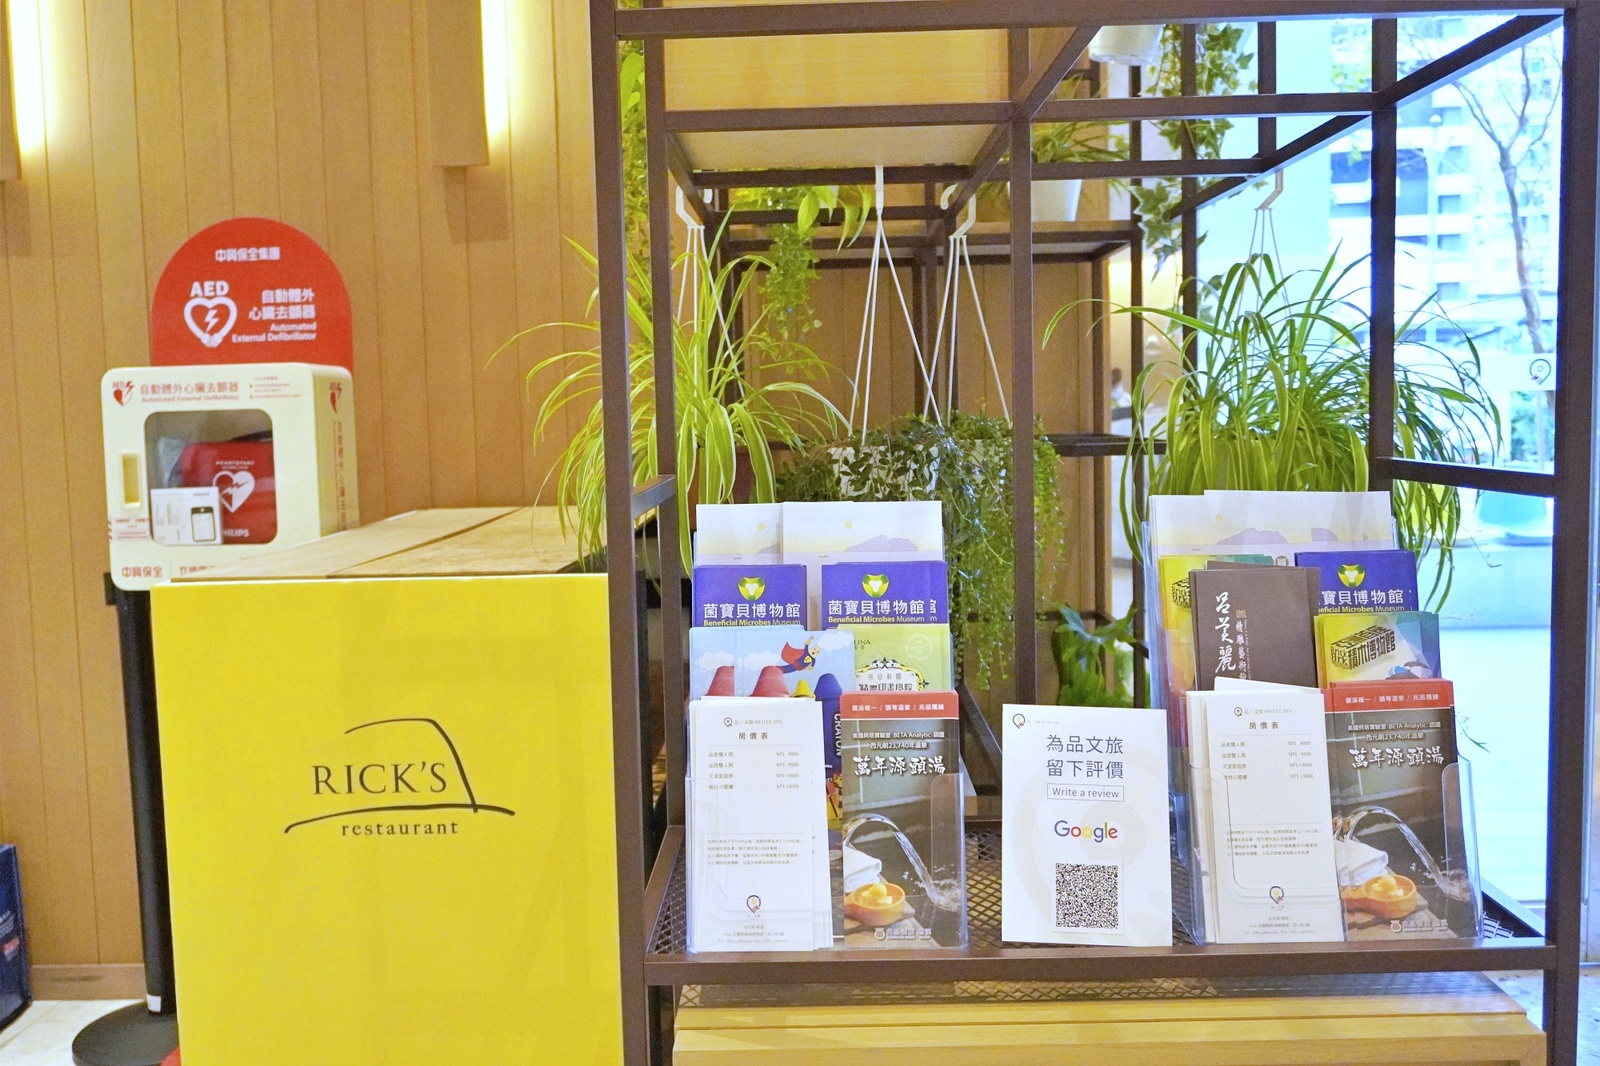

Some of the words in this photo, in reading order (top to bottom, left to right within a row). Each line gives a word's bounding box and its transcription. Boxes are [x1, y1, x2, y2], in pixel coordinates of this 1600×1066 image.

[190, 280, 229, 297] AED
[261, 288, 315, 304] 自動體外
[270, 322, 317, 332] Automated
[232, 333, 266, 343] External
[268, 331, 317, 342] Defibrillator
[1318, 589, 1404, 606] 寶貝博物館
[703, 602, 801, 619] 菌寶貝博物館
[828, 599, 925, 616] 菌寶貝博物館
[703, 619, 738, 627] Beneficial
[828, 615, 862, 624] Beneficial
[863, 615, 895, 623] Microbes
[896, 615, 925, 623] Museum
[1046, 734, 1124, 755] 為品文旅
[1046, 759, 1124, 779] 留下評價
[311, 761, 447, 795] RICK'S
[1052, 786, 1077, 797] Write
[1088, 789, 1119, 798] review
[342, 821, 459, 837] restaurant
[1054, 820, 1118, 843] Google
